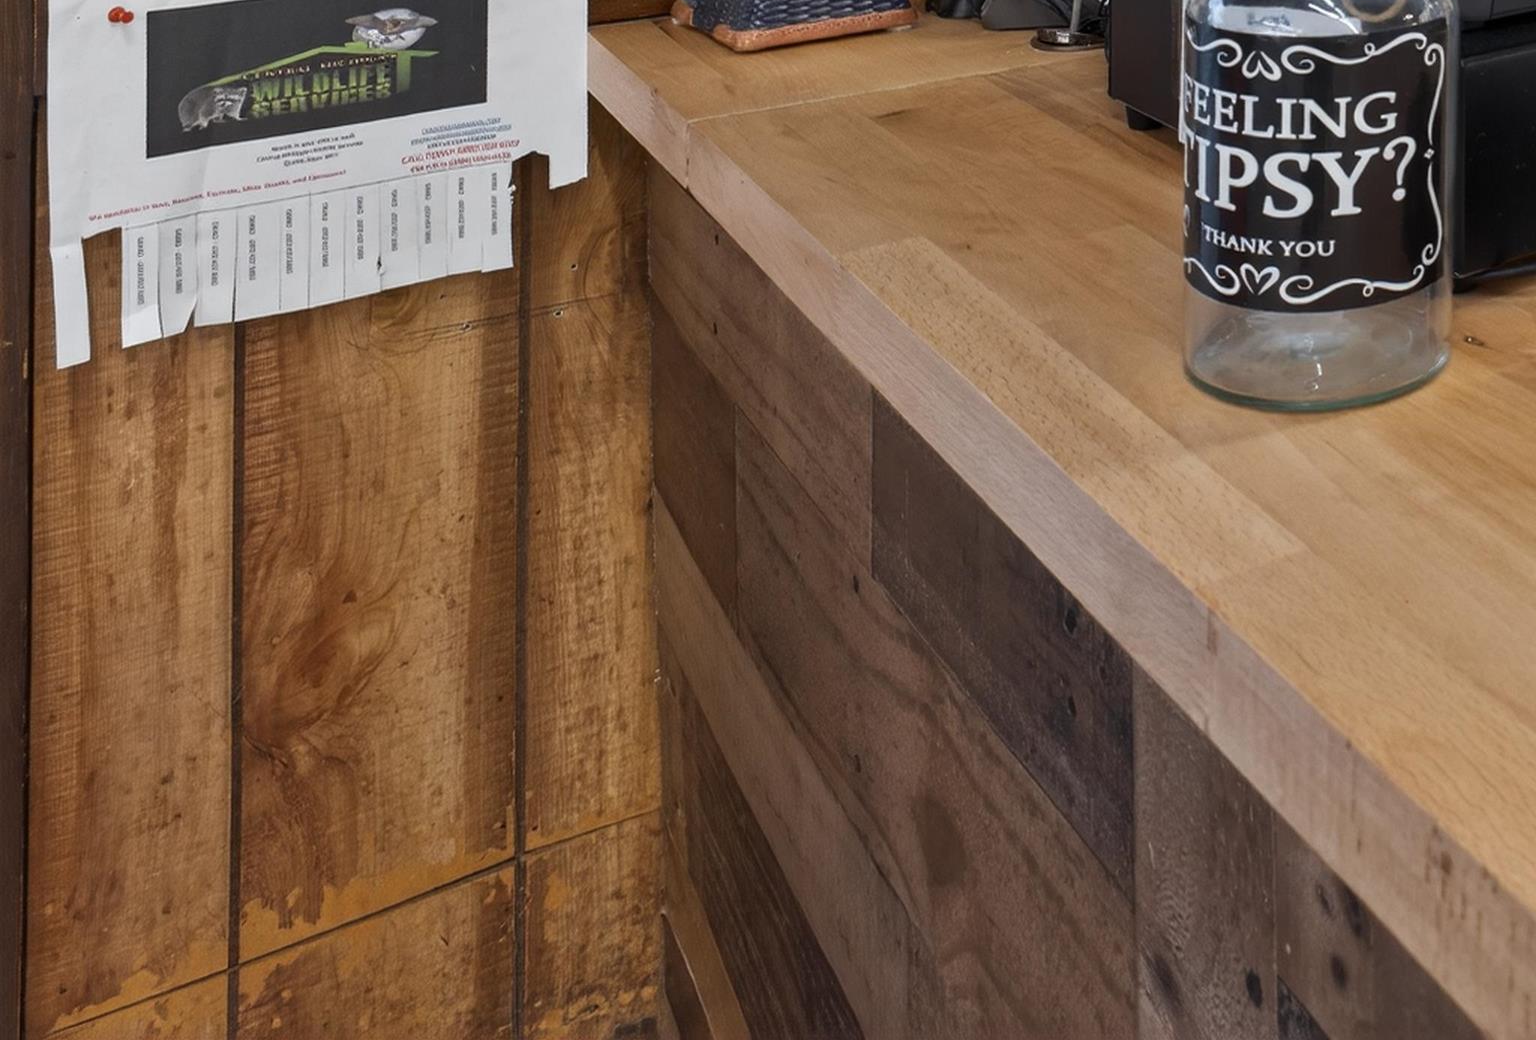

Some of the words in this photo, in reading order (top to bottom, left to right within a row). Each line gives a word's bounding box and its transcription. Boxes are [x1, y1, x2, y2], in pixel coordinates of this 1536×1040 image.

[1184, 72, 1398, 140] FEELING
[1183, 126, 1417, 219] TIPSY?
[1201, 223, 1273, 257] THANK
[1279, 240, 1336, 258] YOU
